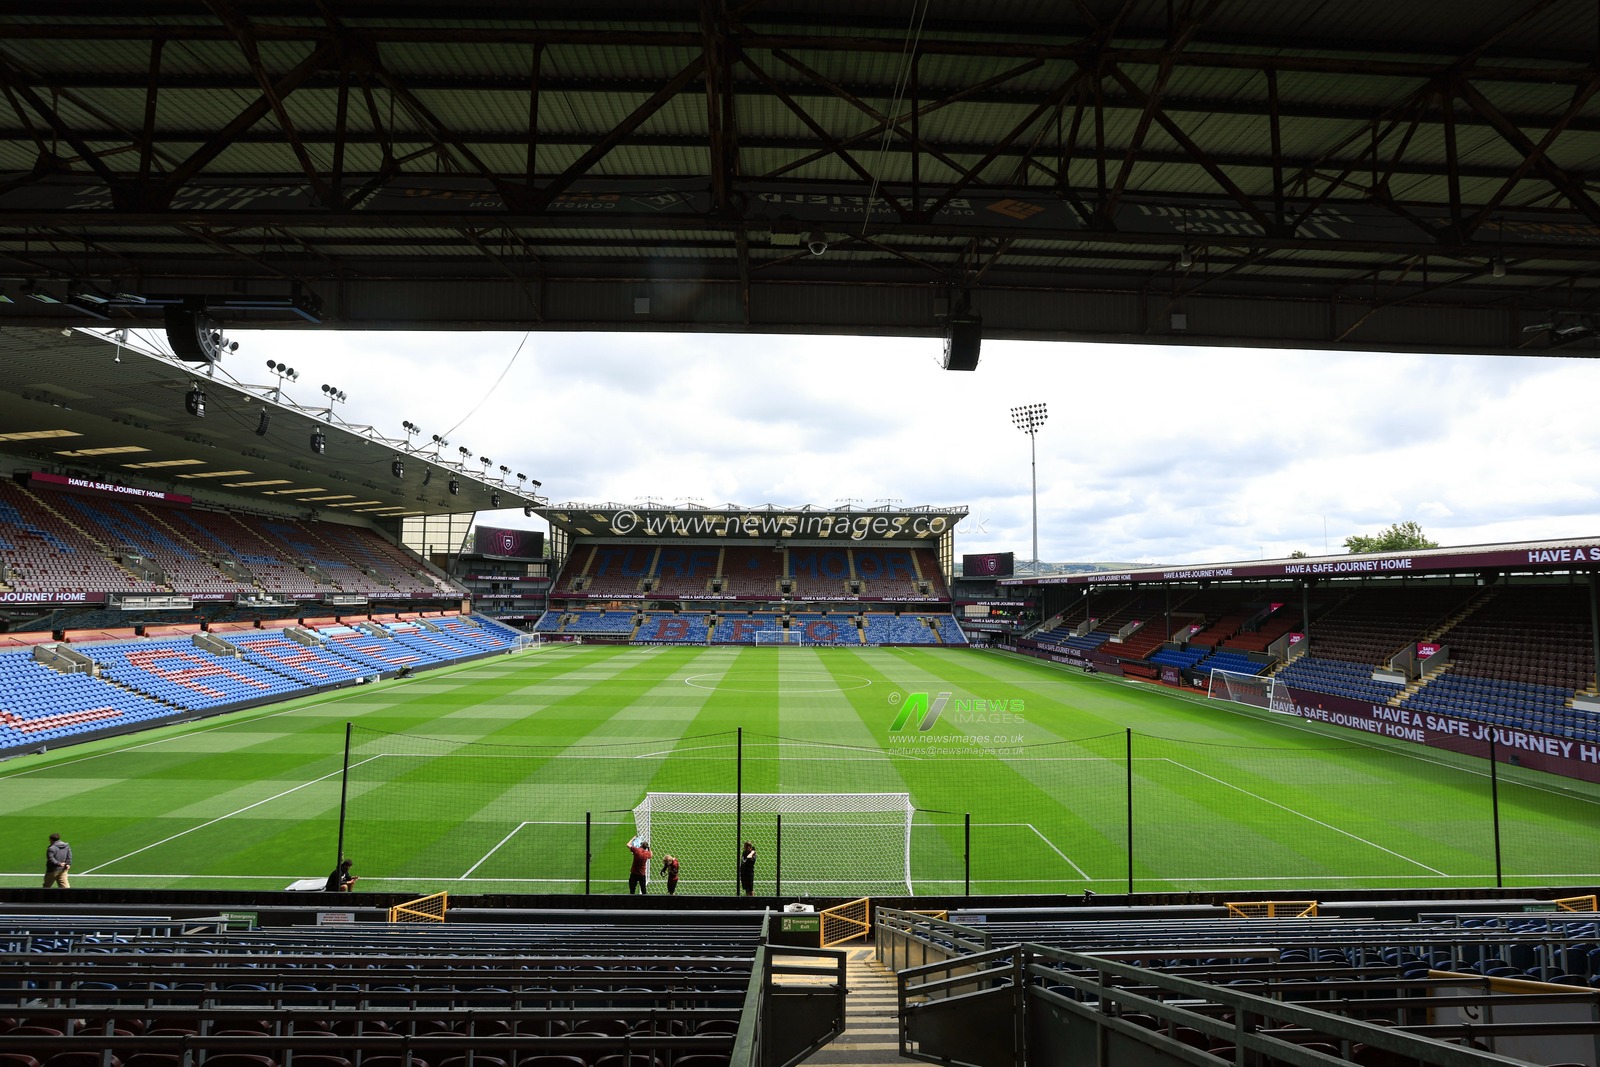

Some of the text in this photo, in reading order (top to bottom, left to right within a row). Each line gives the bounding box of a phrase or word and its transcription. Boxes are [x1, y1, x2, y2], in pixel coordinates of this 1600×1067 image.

[68, 478, 89, 487] HAVE
[95, 482, 113, 492] SAFE
[114, 485, 146, 496] JOURNEY
[146, 490, 165, 499] HOME
[1528, 549, 1571, 563] HAVE
[1573, 548, 1587, 561] A
[1163, 571, 1175, 579] HAVE
[1191, 569, 1215, 578] JOURNEY
[1215, 568, 1233, 577] HOME
[1285, 558, 1412, 574] HAVE A SAFE JOURNEY HOME
[0, 592, 86, 601] JOURNEY HOME
[1272, 700, 1425, 742] HAVE A SAFE JOURNEY HOME
[1372, 705, 1415, 725] HAVE
[1412, 713, 1423, 727] A
[1426, 715, 1470, 738] SAFE
[1472, 724, 1574, 758] JOURNEY
